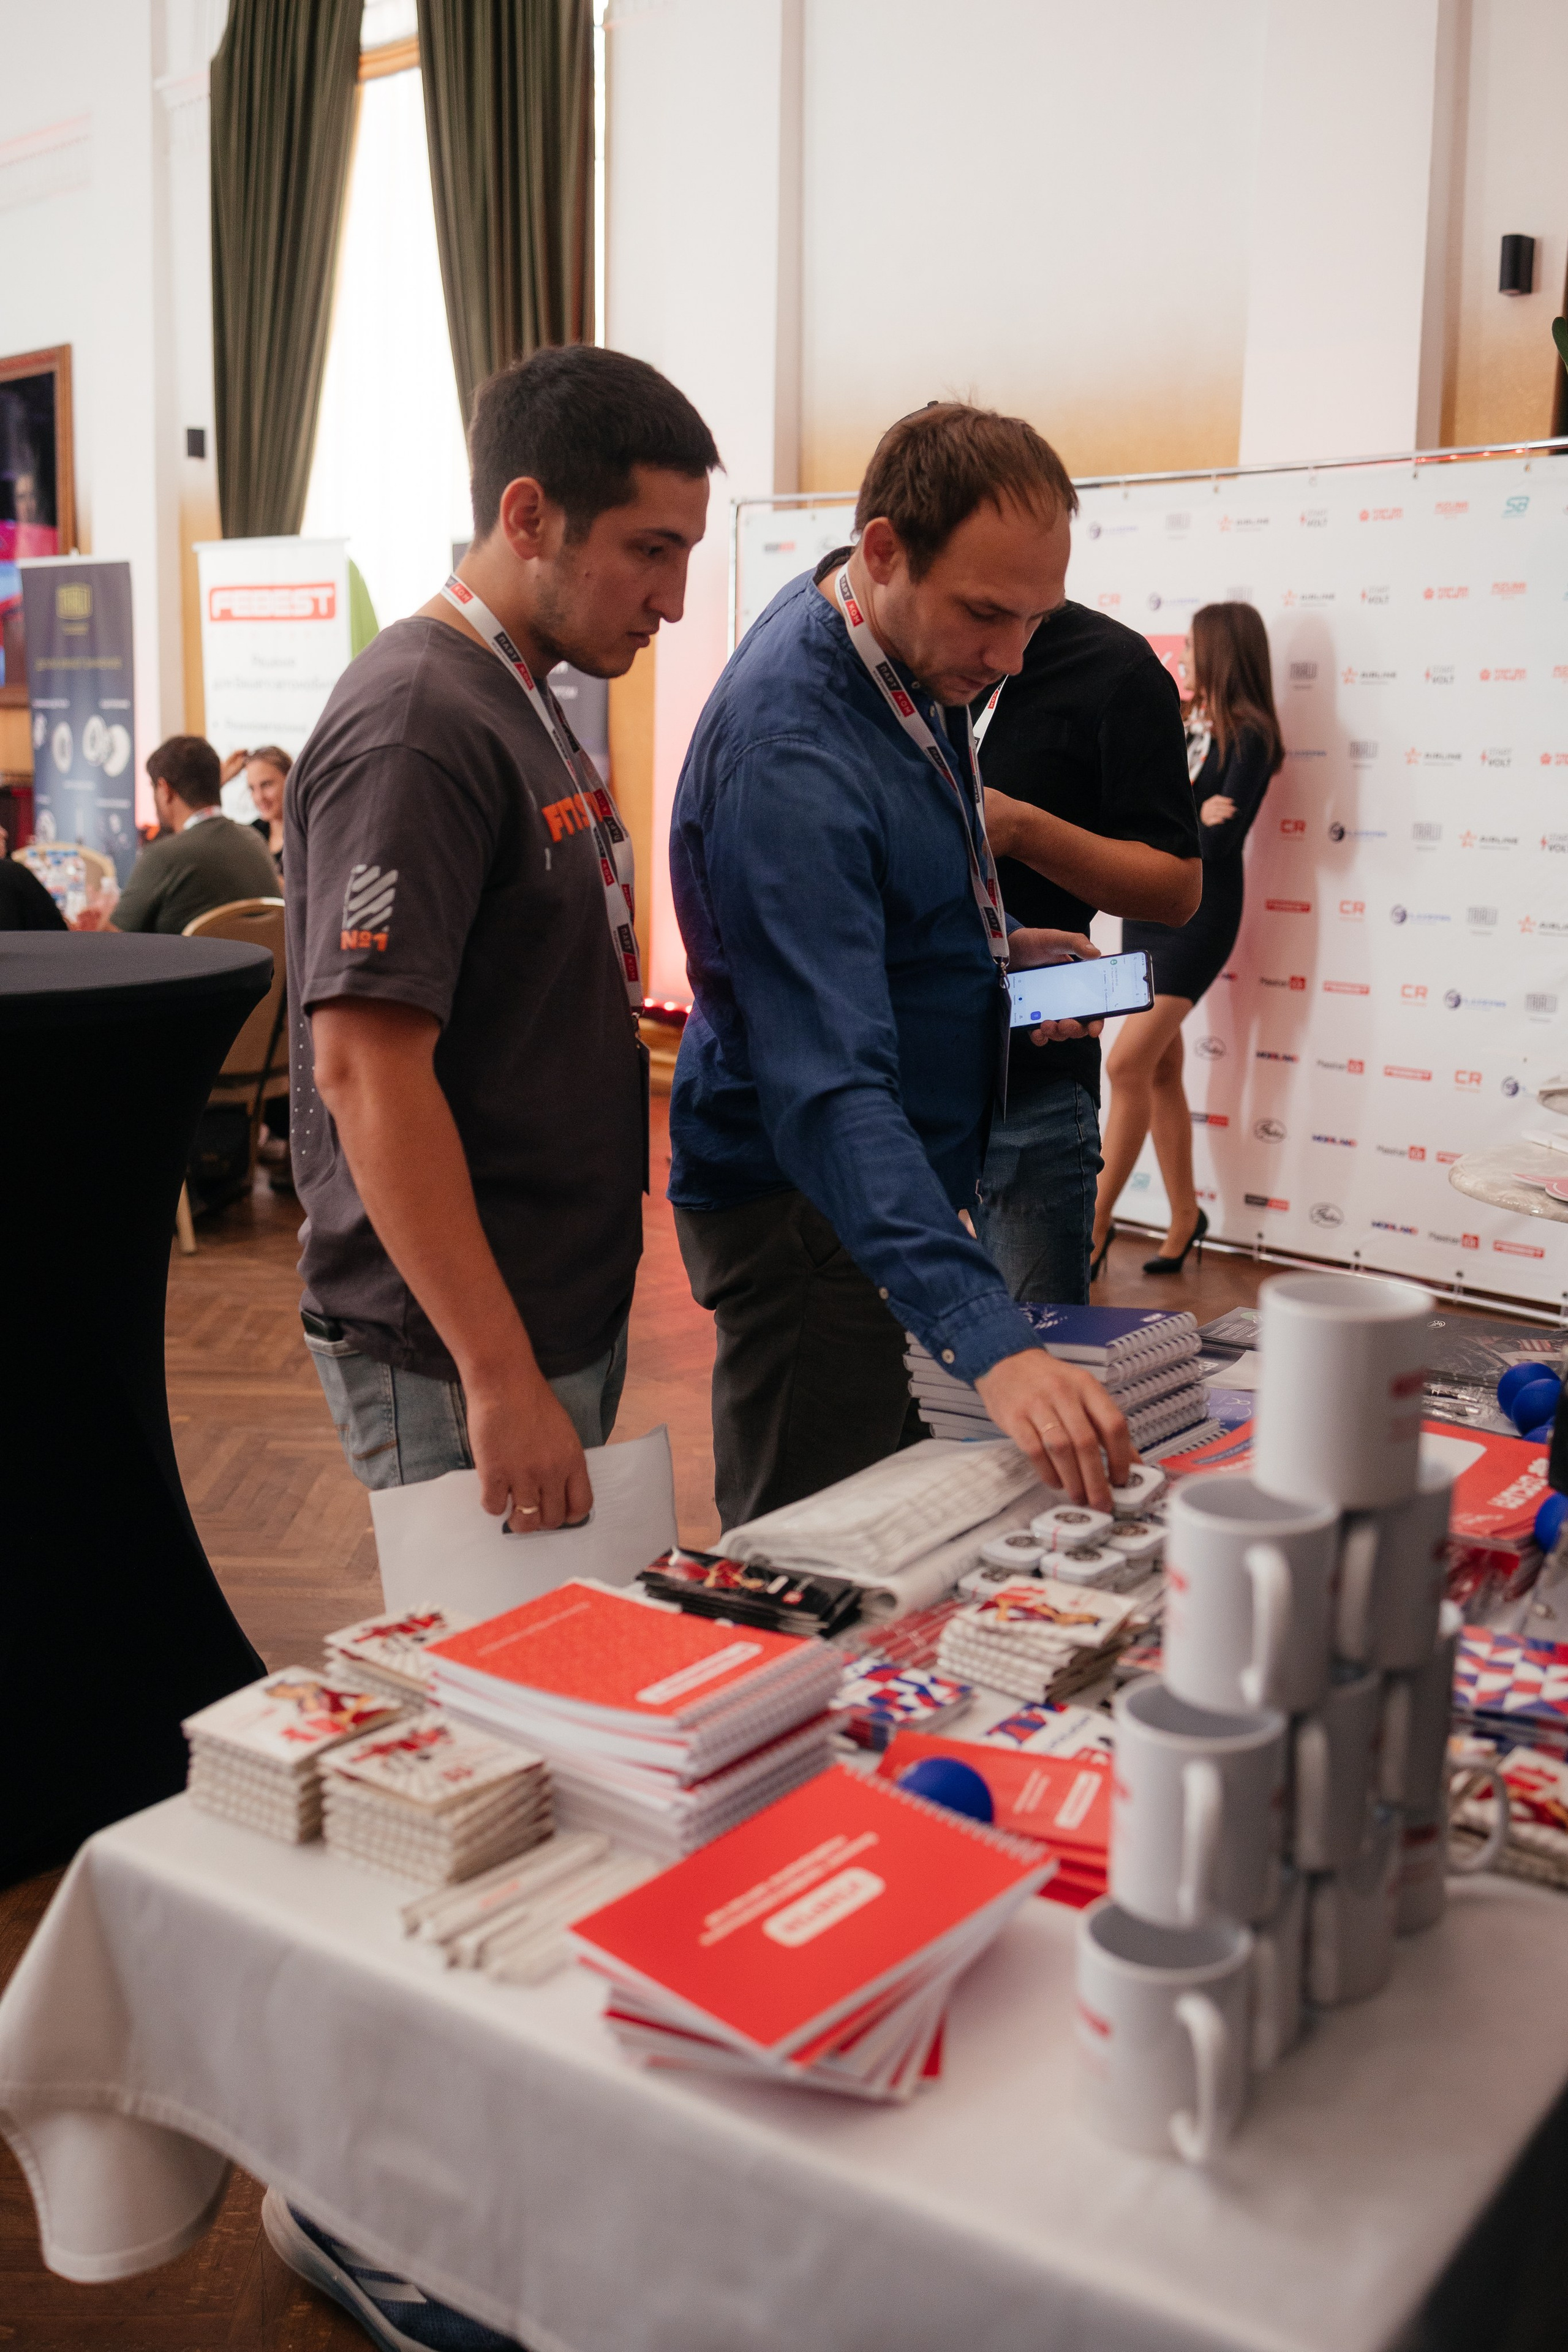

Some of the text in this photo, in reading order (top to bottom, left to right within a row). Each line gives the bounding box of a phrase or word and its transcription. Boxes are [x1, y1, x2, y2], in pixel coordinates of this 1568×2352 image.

[848, 603, 861, 624] КОМ
[497, 635, 518, 660] ПАРТ
[880, 665, 912, 715] ПАРТ КОМ
[1401, 984, 1428, 999] CR
[1455, 1070, 1483, 1085] CR
